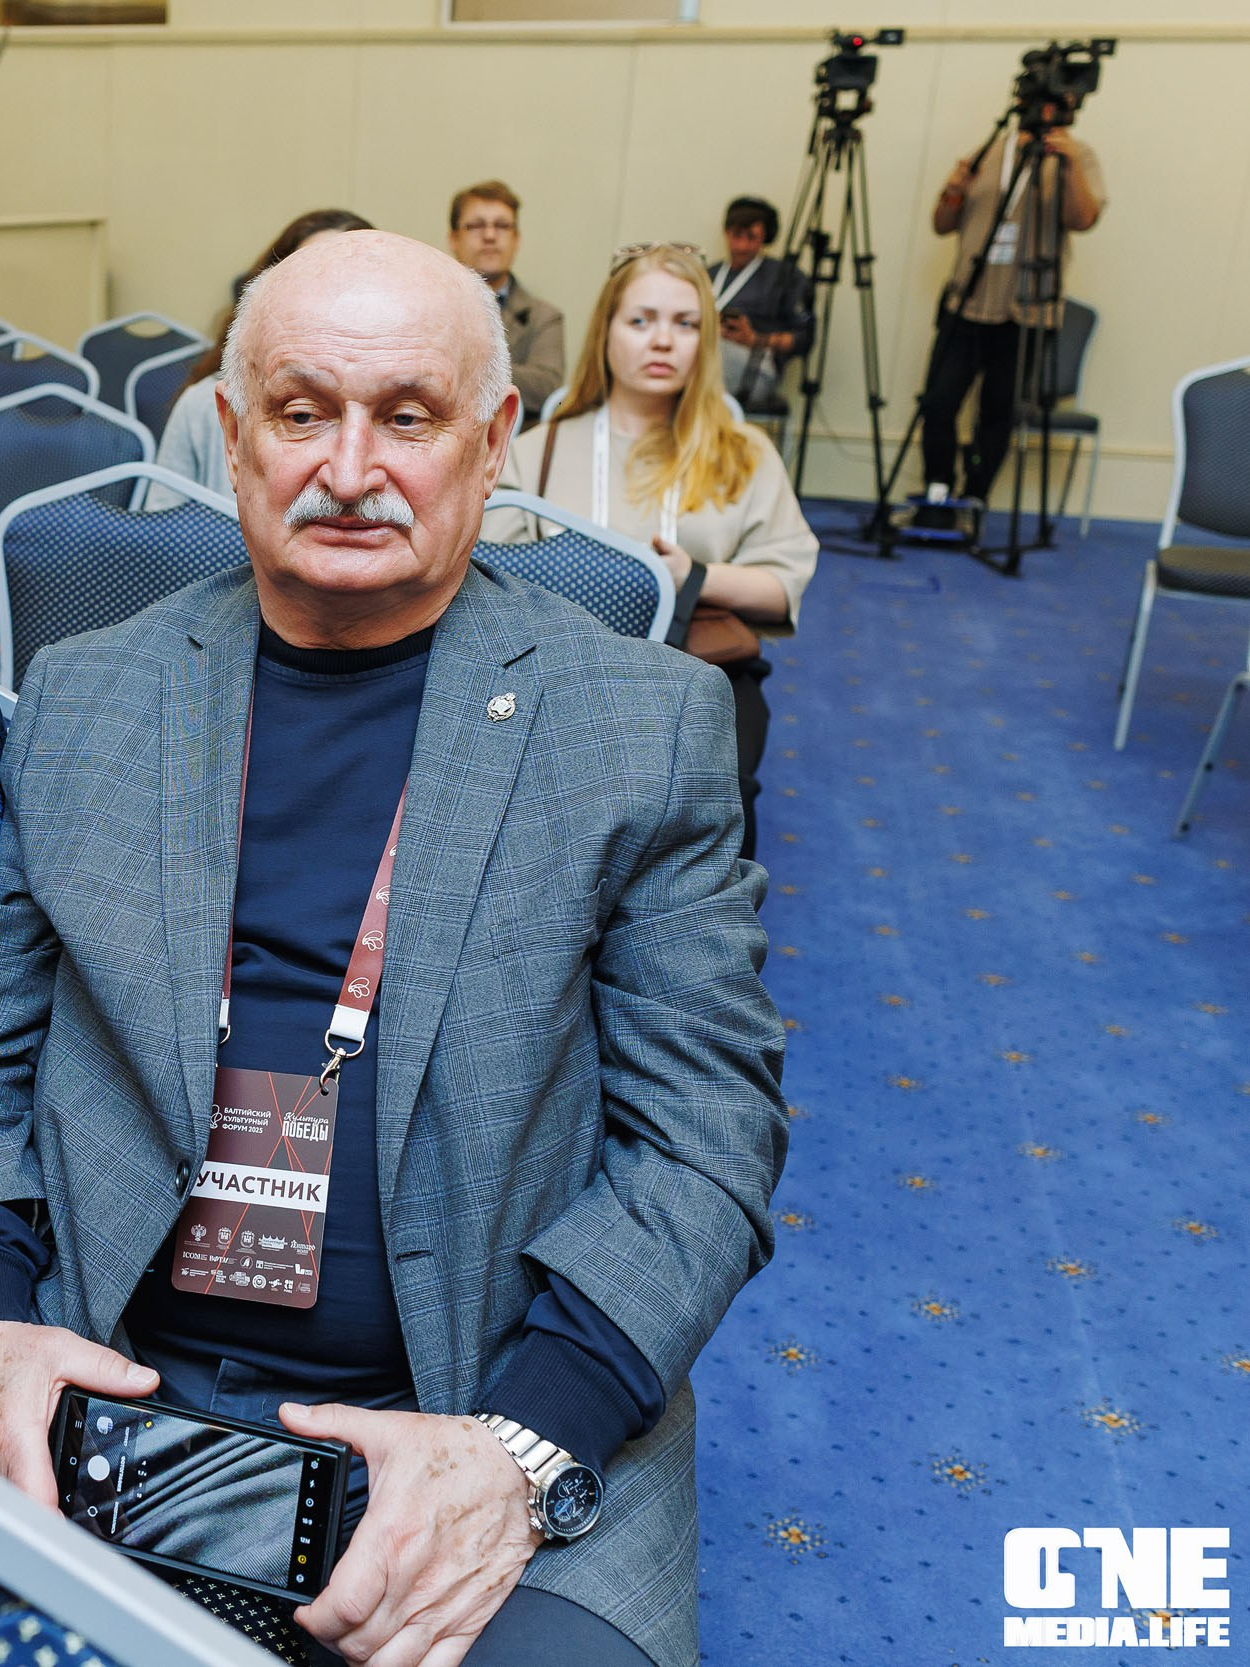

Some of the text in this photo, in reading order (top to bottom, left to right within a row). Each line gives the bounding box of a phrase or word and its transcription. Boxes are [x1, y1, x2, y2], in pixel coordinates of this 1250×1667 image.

[224, 1107, 271, 1118] БАЛТИЙСКИЙ
[223, 1115, 269, 1126] КУЛЬТУРНЫЙ
[284, 1112, 329, 1127] Культура
[222, 1123, 264, 1134] ФОРУМ 2025
[282, 1120, 329, 1142] ПОБЕДЫ
[196, 1170, 322, 1202] УЧАСТНИК
